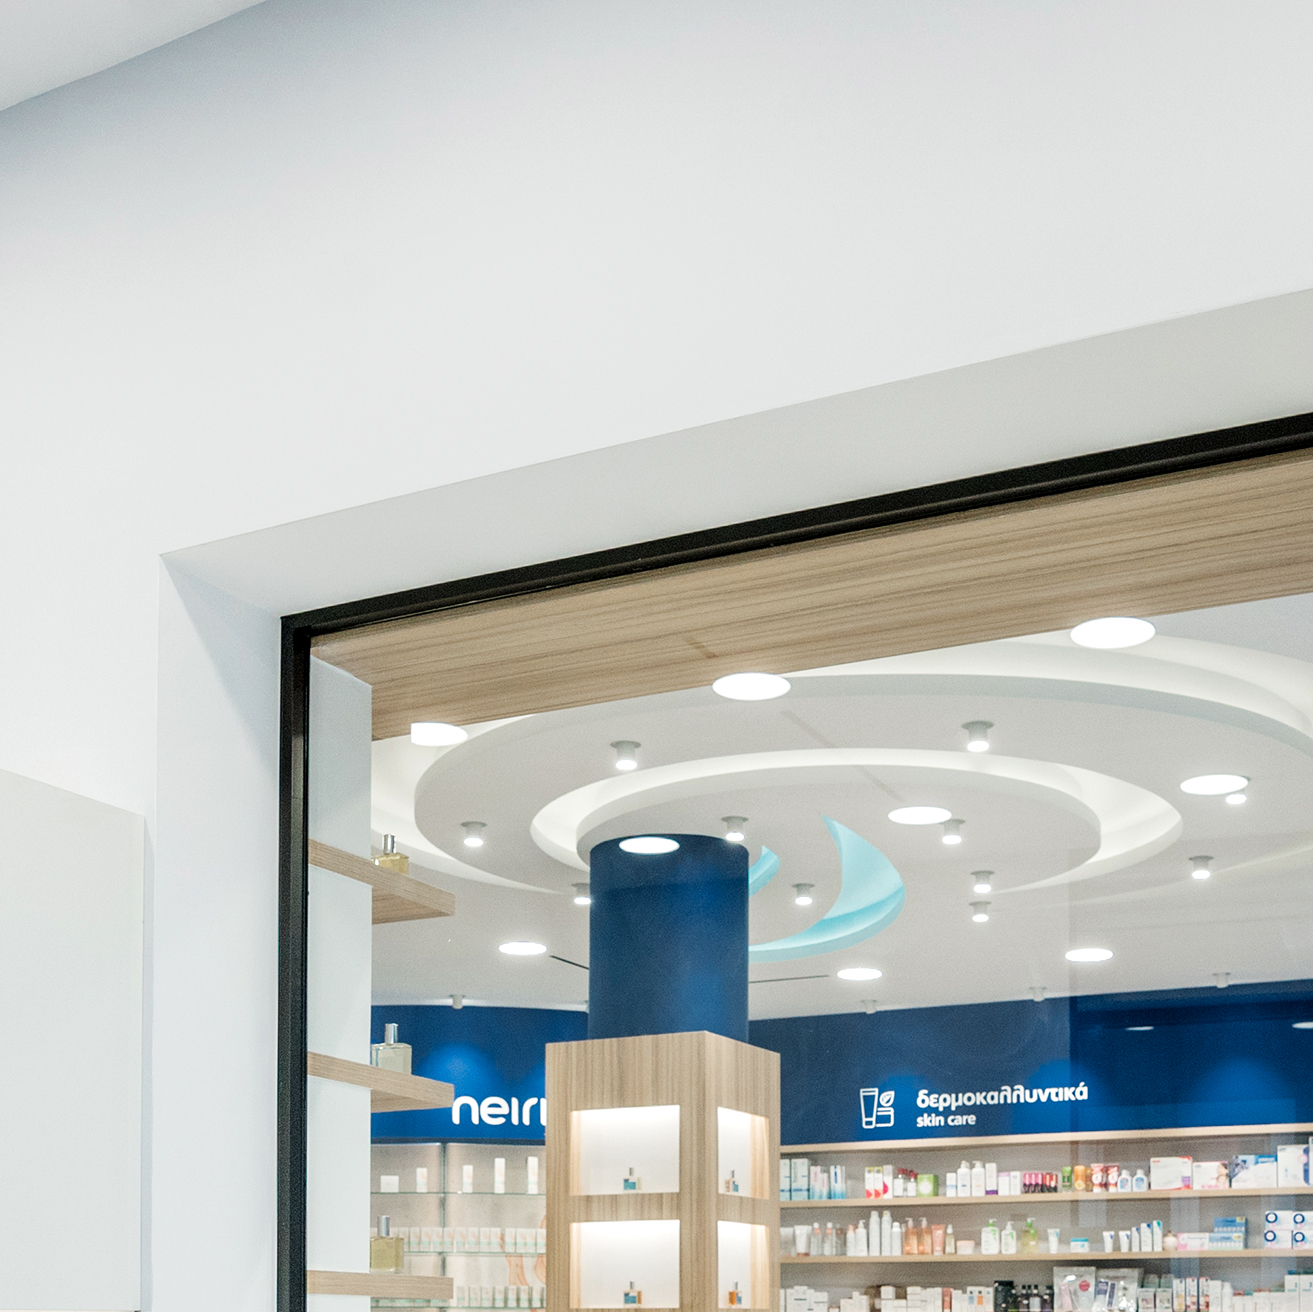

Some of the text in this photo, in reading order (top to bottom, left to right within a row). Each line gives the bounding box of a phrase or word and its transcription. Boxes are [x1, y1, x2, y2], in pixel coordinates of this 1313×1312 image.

[916, 1082, 1089, 1111] δερμοκαλλυντικά
[916, 1113, 977, 1128] skin care
